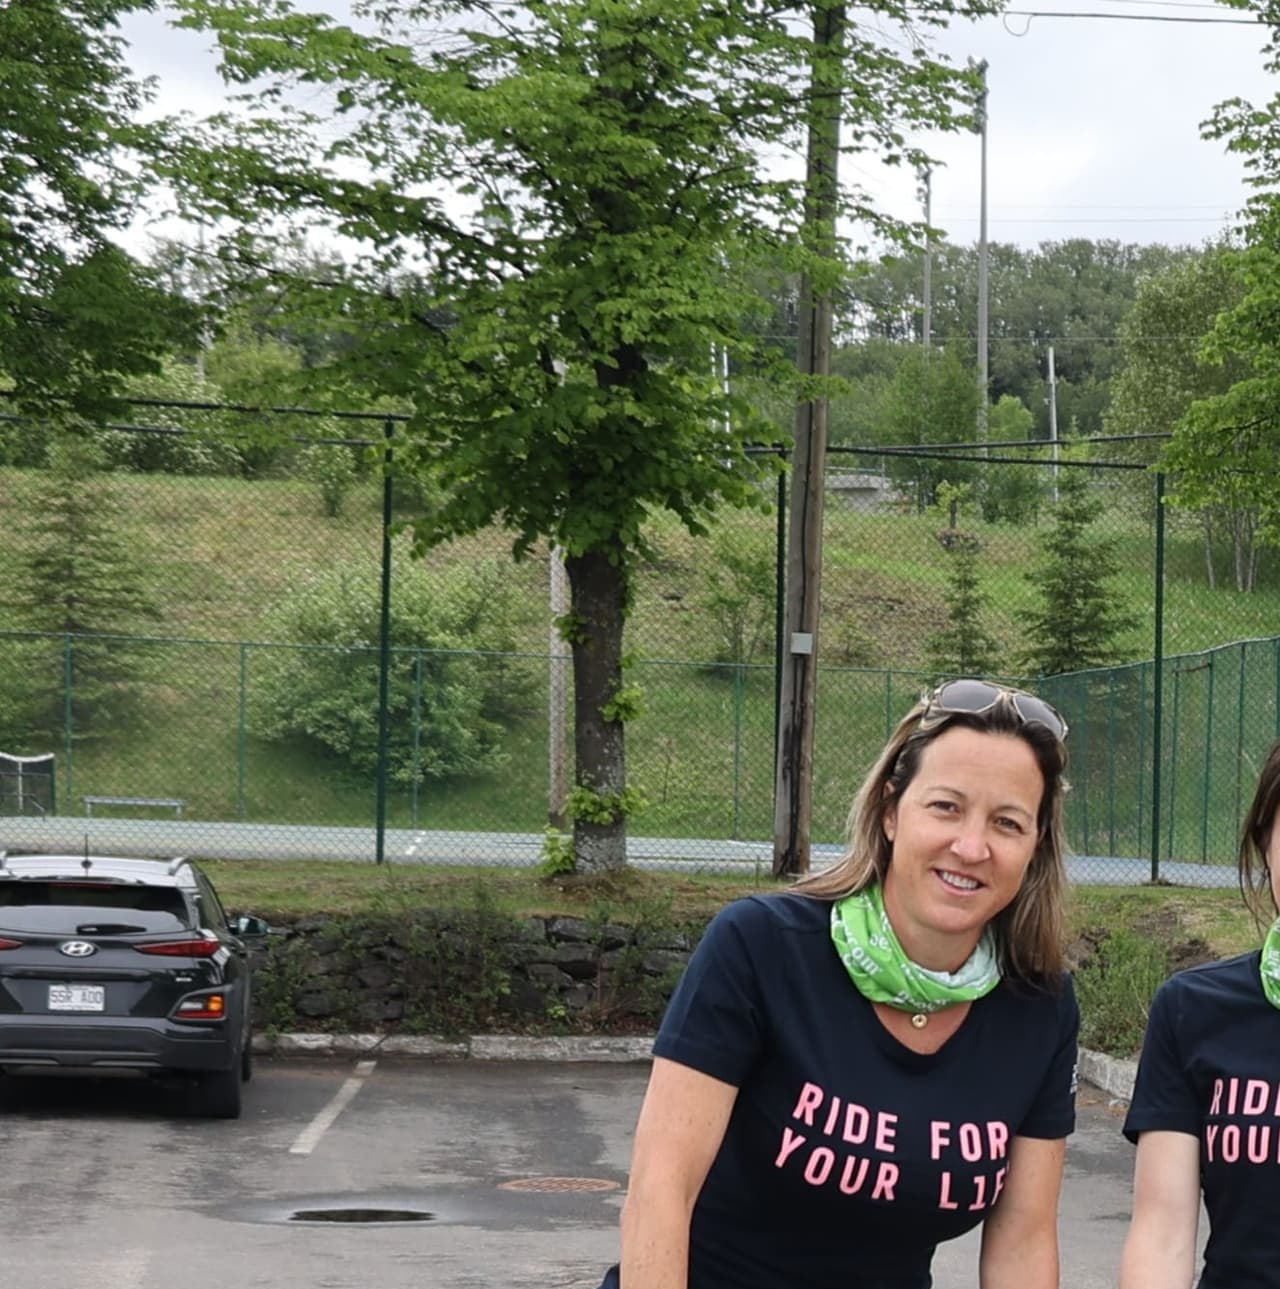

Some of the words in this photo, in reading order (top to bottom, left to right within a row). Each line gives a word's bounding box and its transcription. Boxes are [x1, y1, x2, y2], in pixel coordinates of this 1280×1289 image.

[792, 1081, 899, 1154] RIDE
[930, 1120, 1009, 1162] FOR
[774, 1127, 900, 1202] YOUR
